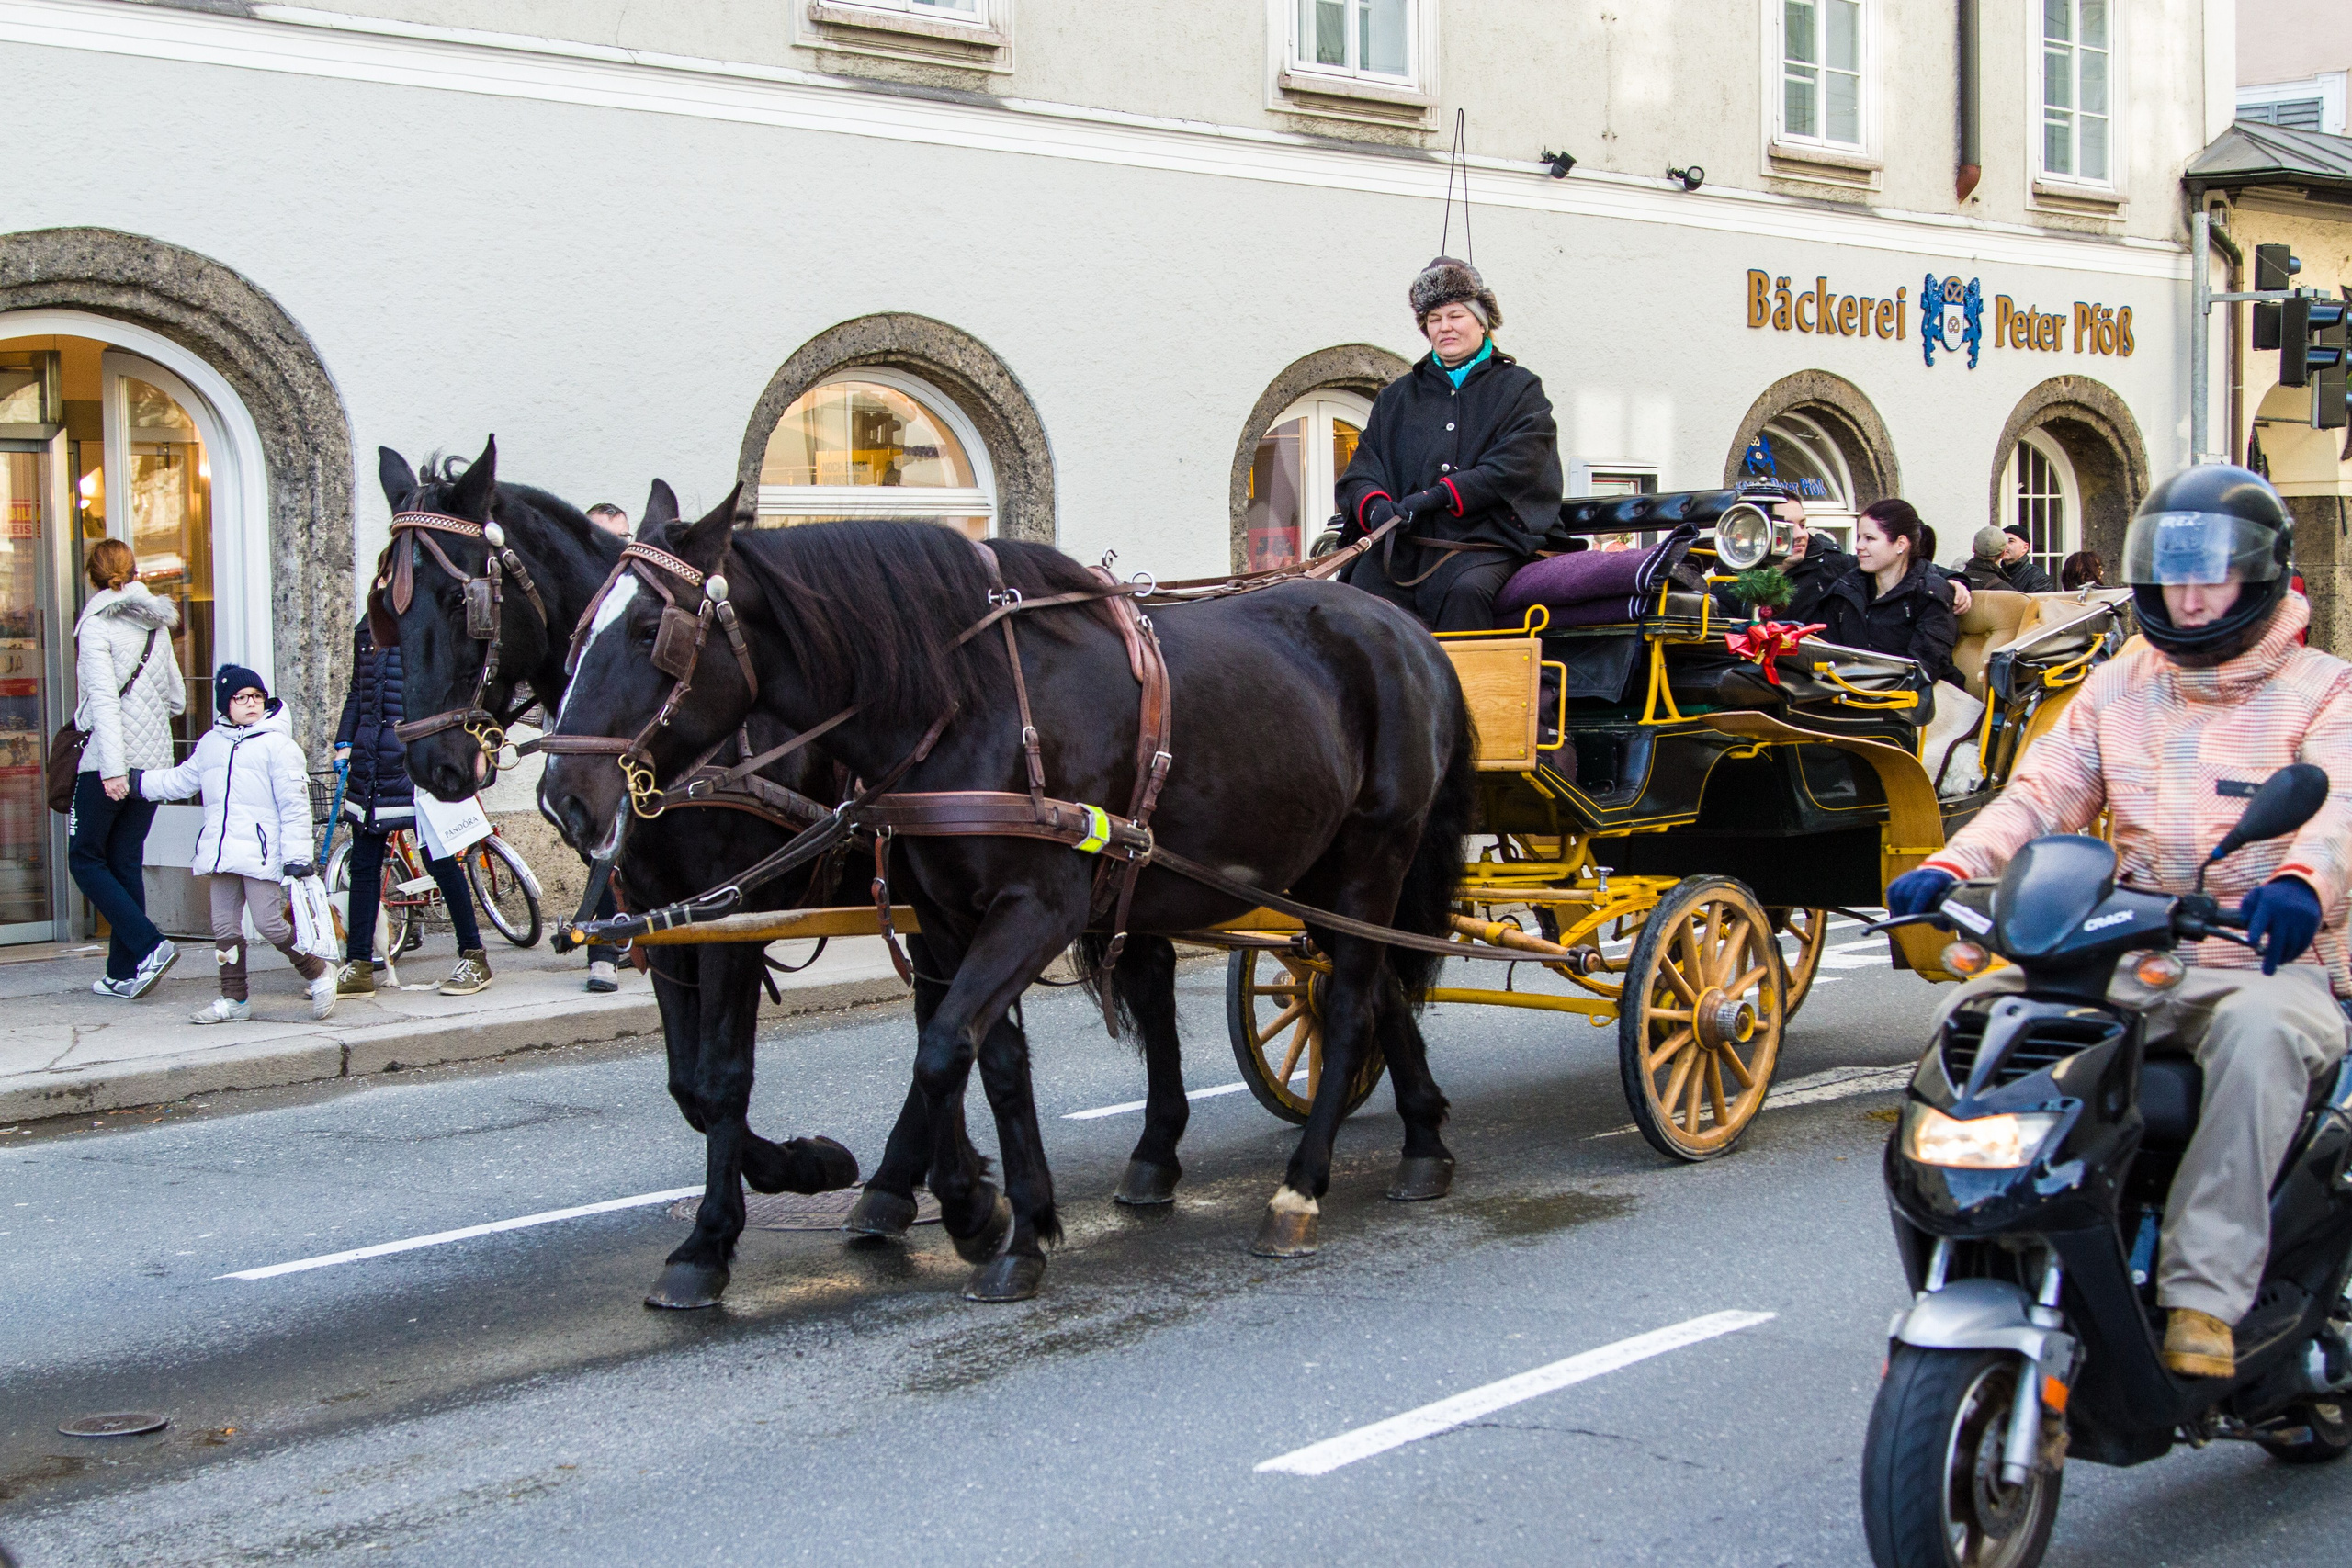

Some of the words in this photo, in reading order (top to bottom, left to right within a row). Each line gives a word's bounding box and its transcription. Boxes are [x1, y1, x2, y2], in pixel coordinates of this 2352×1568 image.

[1747, 268, 1906, 340] Bäckerei
[1995, 294, 2066, 351] Peter
[2074, 301, 2134, 356] Pföß
[846, 461, 868, 472] ENEN
[1799, 477, 1827, 496] Pföß
